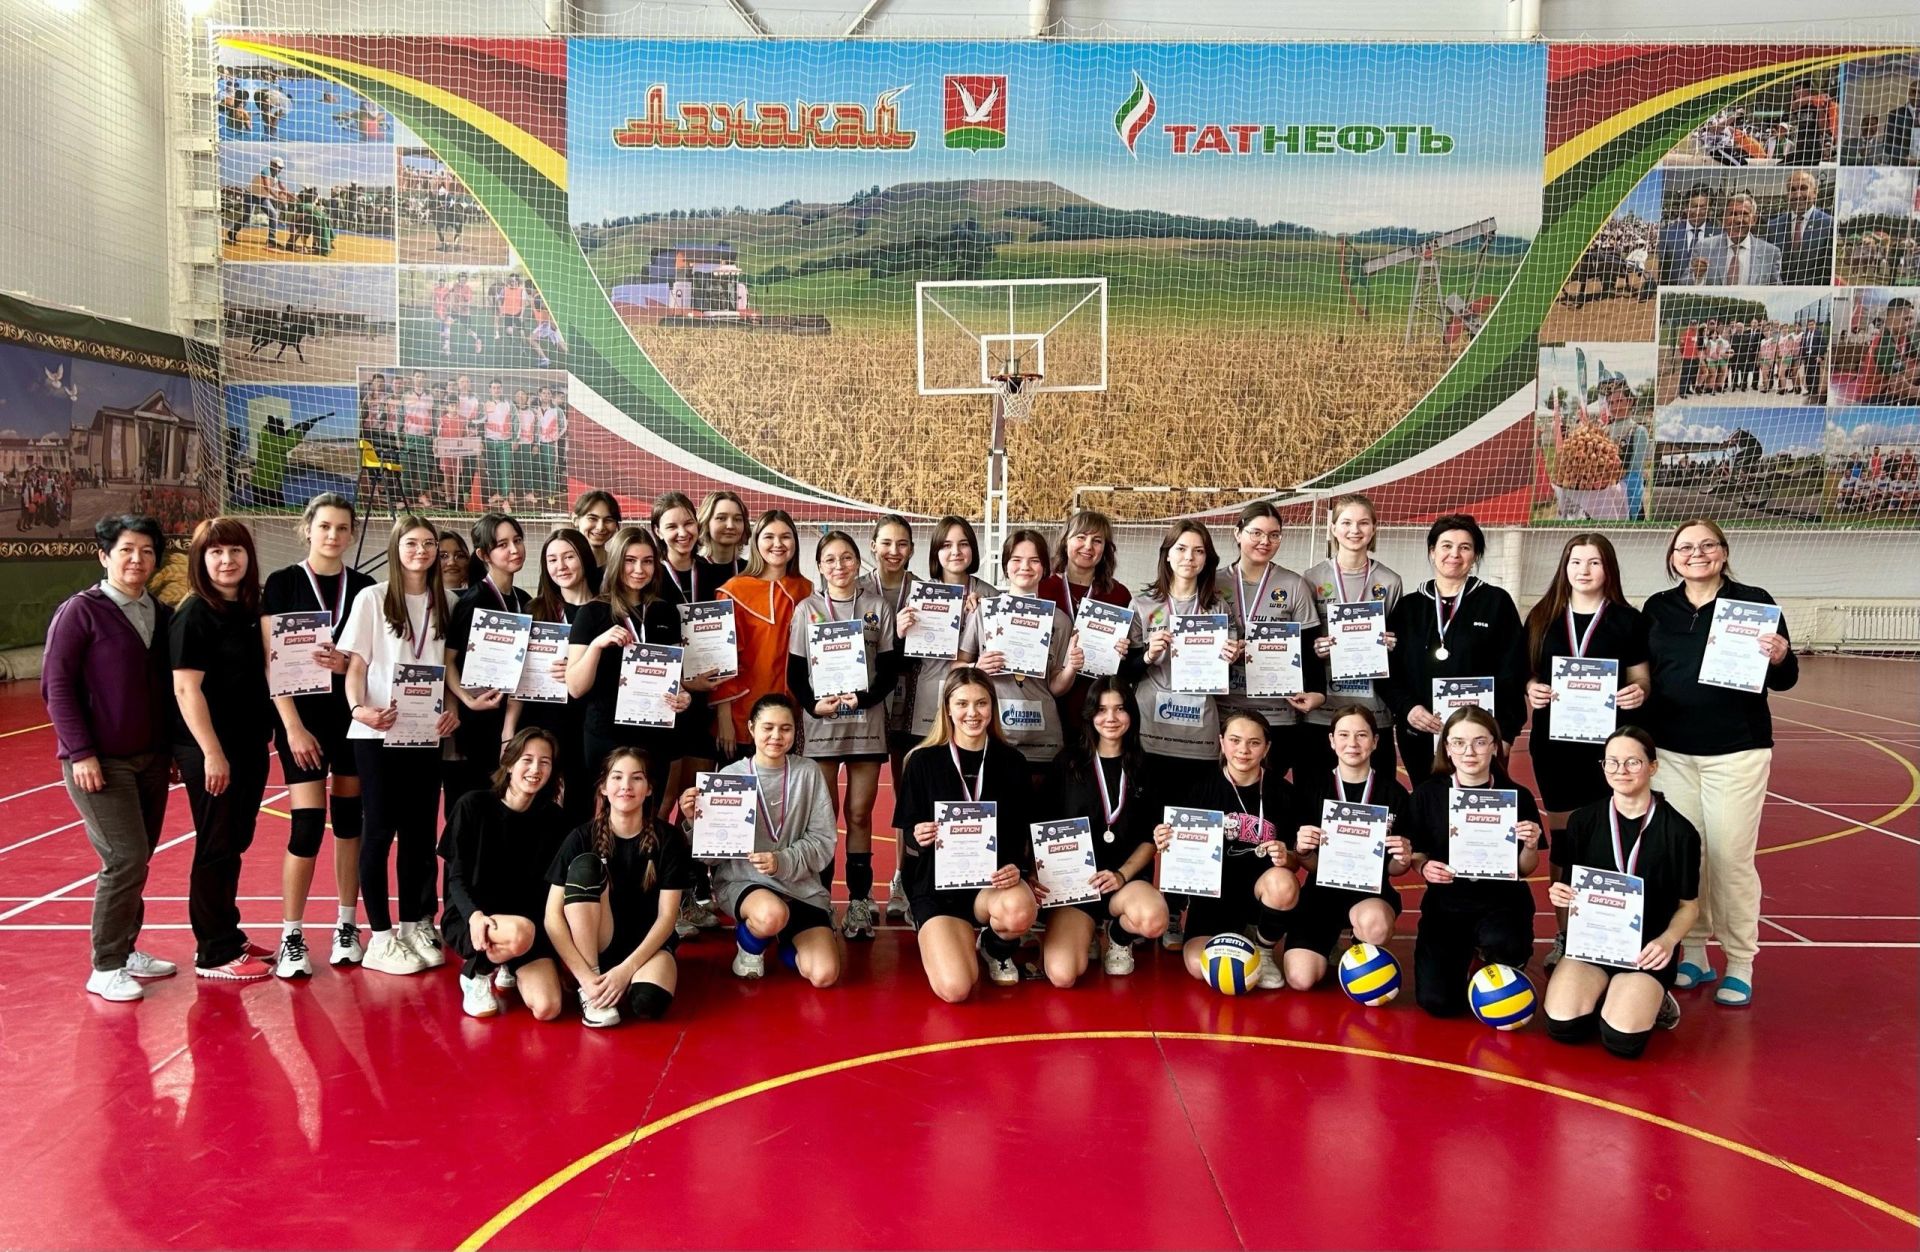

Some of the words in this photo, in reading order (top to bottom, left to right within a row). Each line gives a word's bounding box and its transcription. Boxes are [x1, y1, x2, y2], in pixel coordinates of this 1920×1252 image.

[1163, 124, 1455, 156] ТАТНЕФТЬ
[923, 604, 948, 612] ДИПЛОМ
[1012, 617, 1038, 627] ДИПЛОМ
[695, 623, 721, 631] ДИПЛОМ
[1088, 621, 1115, 633] ДИПЛОМ
[1343, 624, 1371, 632] ДИПЛОМ
[1727, 624, 1758, 636] ДИПЛОМ
[285, 635, 315, 644] ДИПЛОМ
[485, 634, 514, 644] ДИПЛОМ
[824, 643, 850, 651] ДИПЛОМ
[636, 666, 665, 676] ДИПЛОМ
[1568, 681, 1600, 690] ДИПЛОМ
[405, 687, 431, 695] ДИПЛОМ
[1172, 704, 1201, 714] ГАЗПРОМ
[1015, 710, 1041, 718] ГАЗПРОМ
[711, 797, 741, 805] ДИПЛОМ
[1467, 815, 1500, 823] ДИПЛОМ
[1338, 826, 1369, 836] ДИПЛОМ
[1178, 832, 1208, 841] ДИПЛОМ
[1049, 843, 1077, 853] ДИПЛОМ
[1590, 894, 1625, 908] ДИПЛОМ
